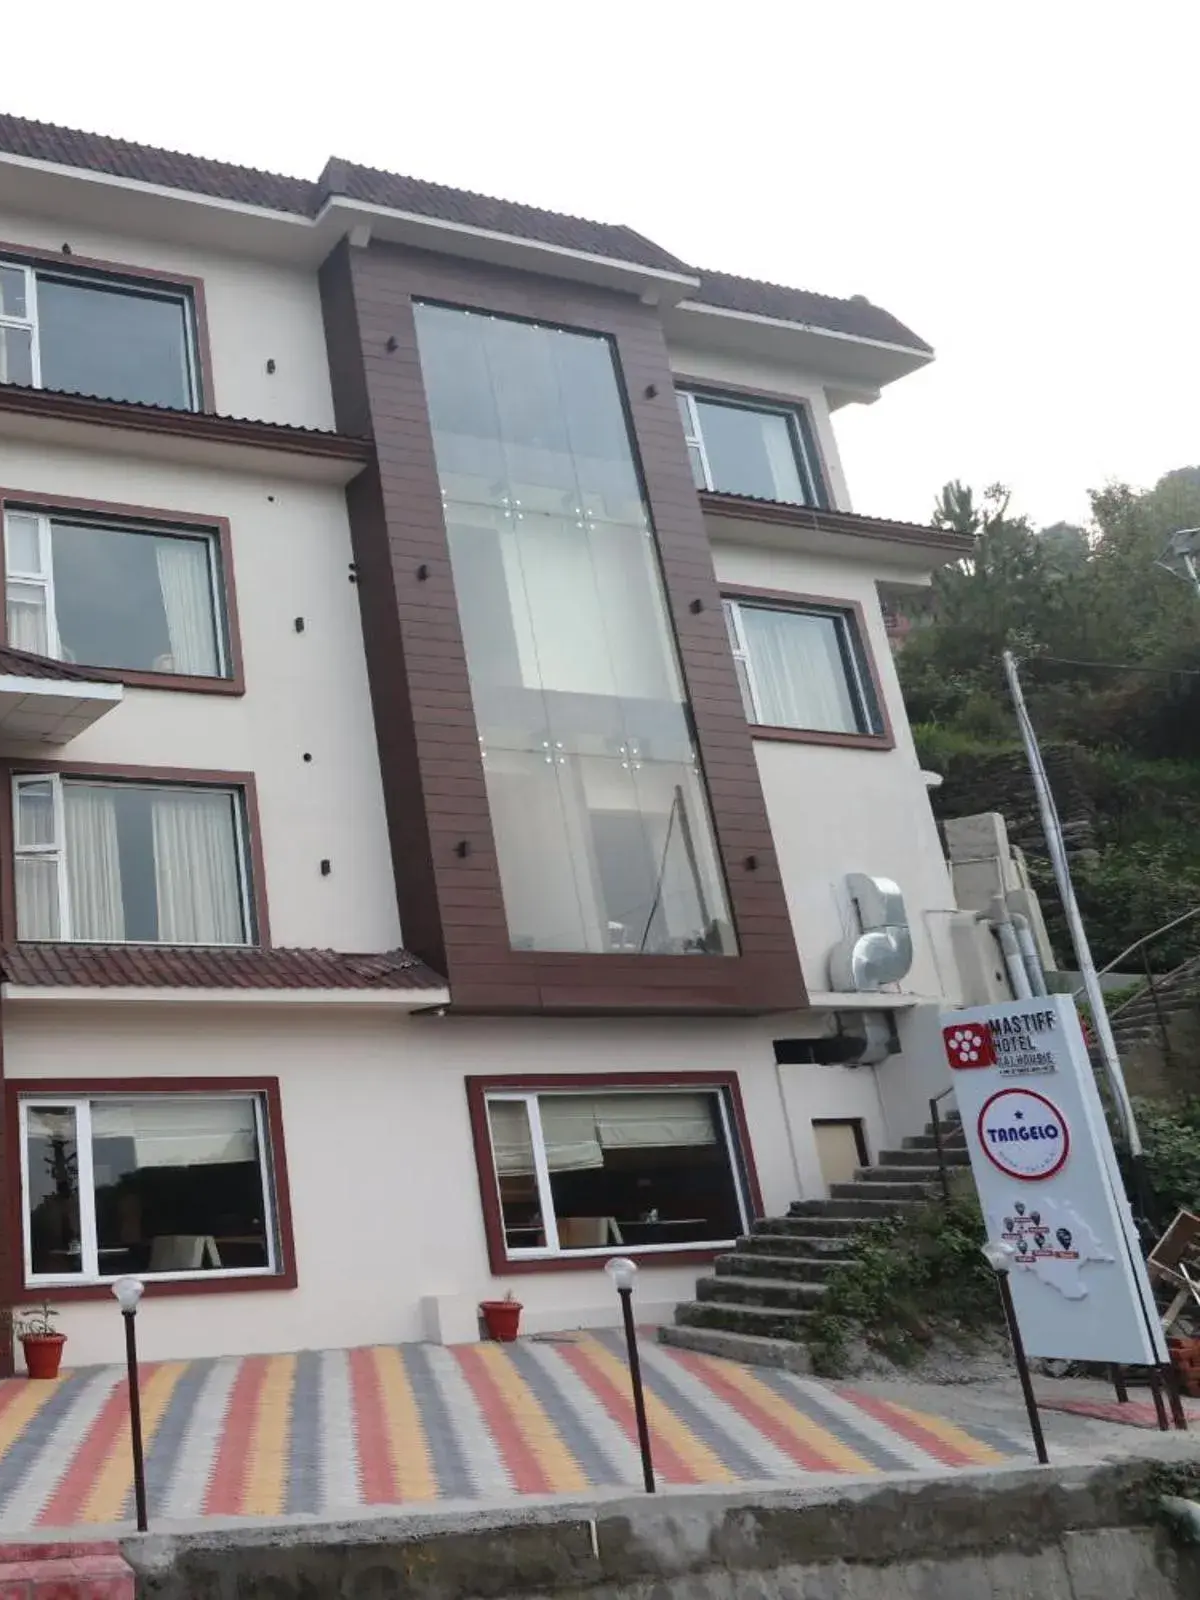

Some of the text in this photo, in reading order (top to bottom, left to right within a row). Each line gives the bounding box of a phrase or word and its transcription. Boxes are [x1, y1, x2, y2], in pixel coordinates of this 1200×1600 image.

[988, 1010, 1055, 1035] MASTIFF
[993, 1035, 1036, 1052] HOTEL
[987, 1124, 1059, 1143] TANGELO
